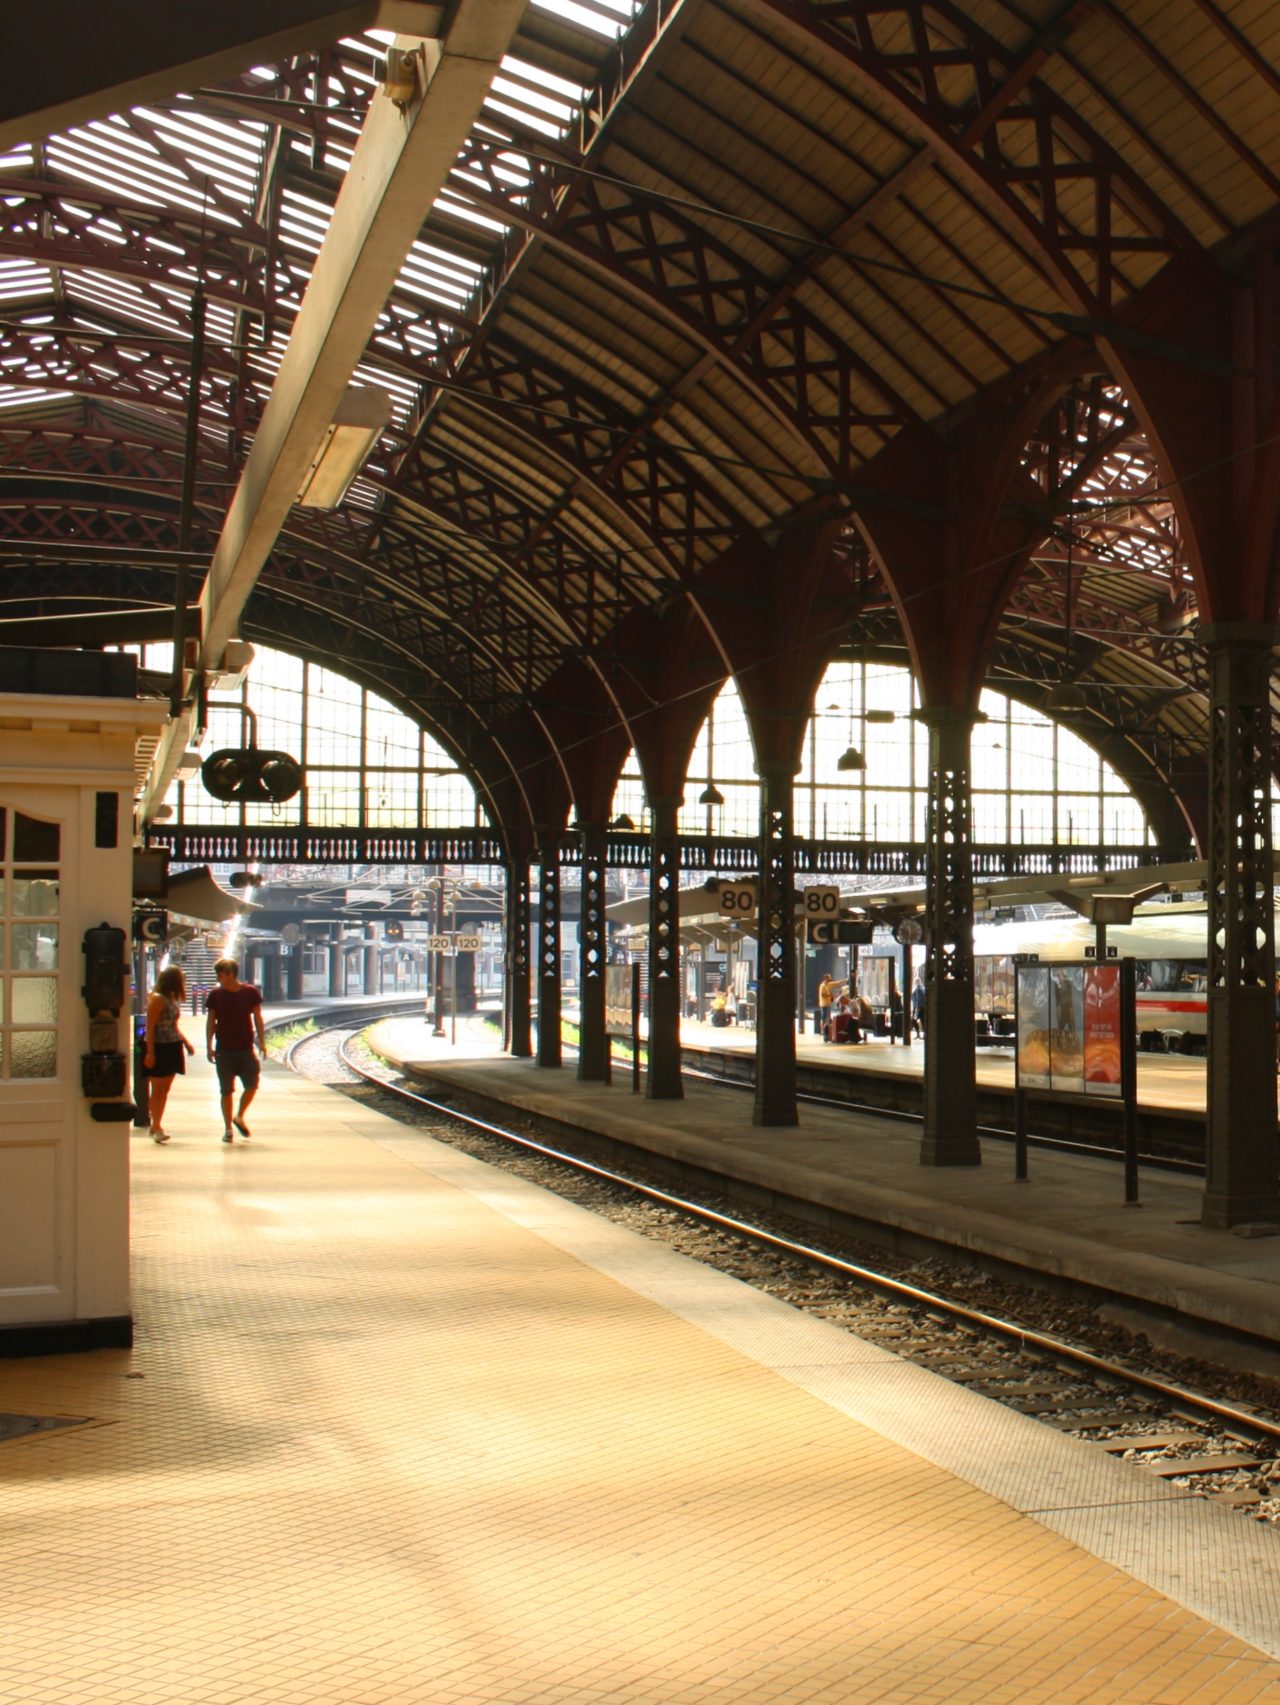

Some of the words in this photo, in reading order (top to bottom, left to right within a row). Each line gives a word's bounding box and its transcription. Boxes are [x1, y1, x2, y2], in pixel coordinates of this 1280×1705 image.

[721, 890, 753, 910] 80
[807, 892, 837, 912] 80
[142, 917, 160, 939] C
[429, 938, 449, 948] 120
[458, 938, 479, 948] 120
